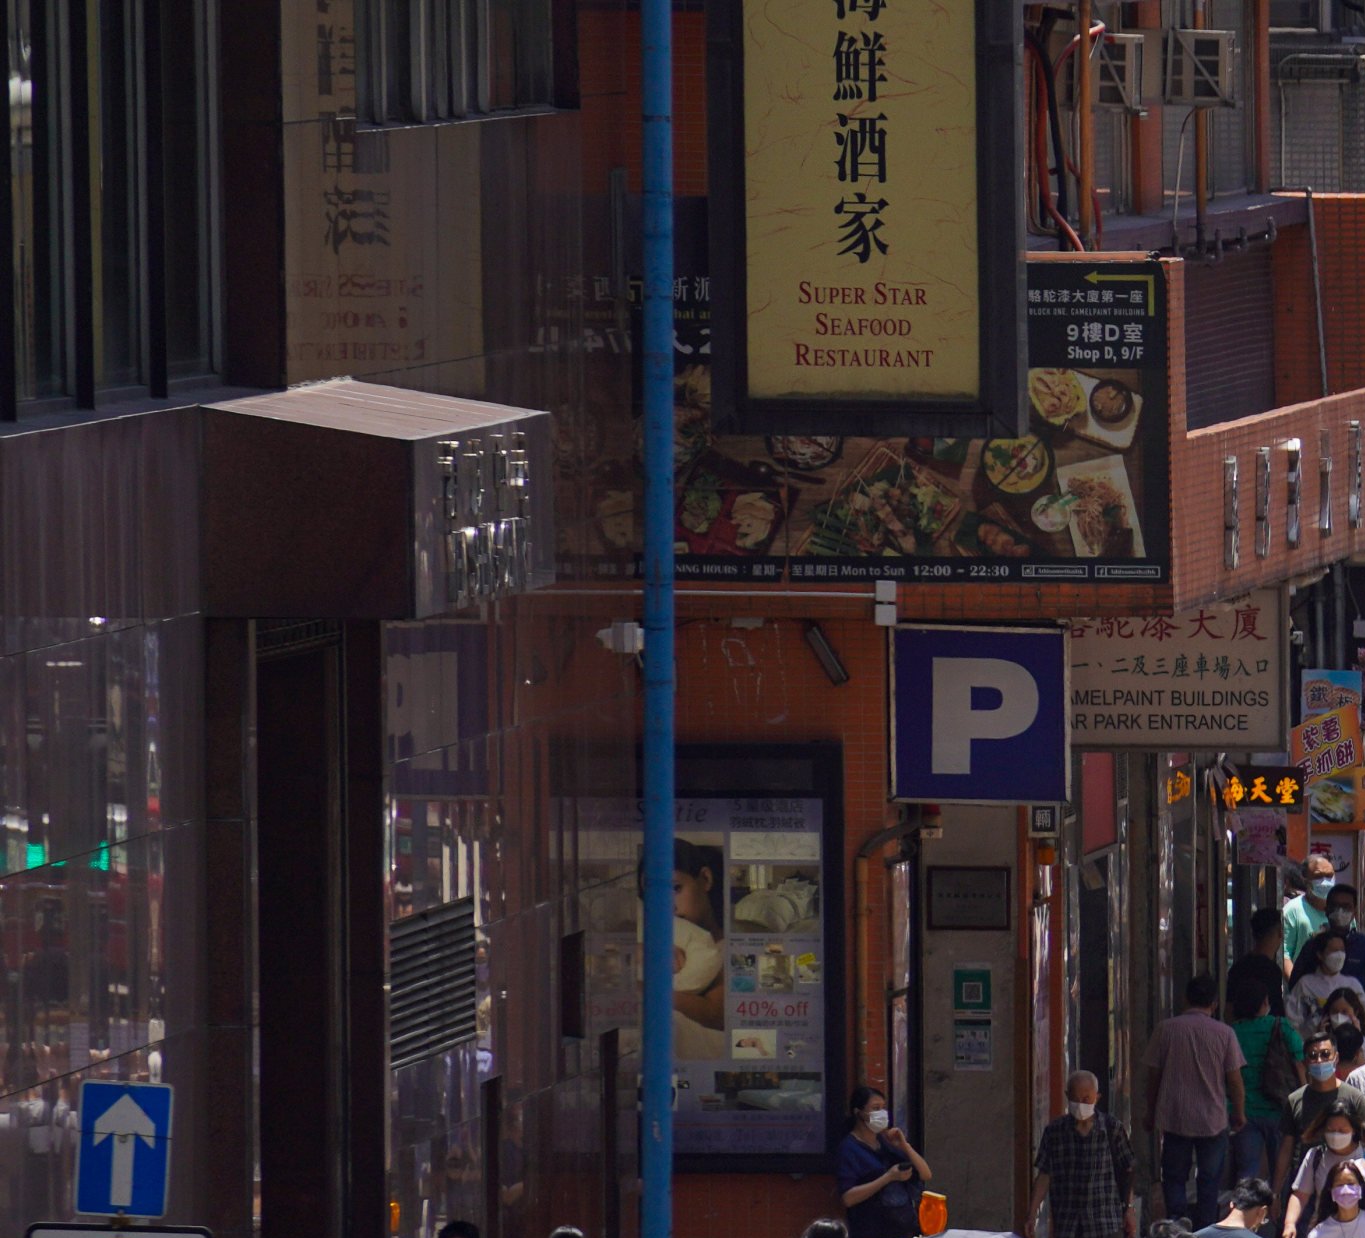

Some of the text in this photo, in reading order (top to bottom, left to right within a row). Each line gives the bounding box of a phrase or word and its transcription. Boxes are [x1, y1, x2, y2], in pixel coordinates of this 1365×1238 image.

[798, 280, 928, 307] SUPER STAR
[1028, 307, 1051, 317] BLOCK
[1113, 307, 1146, 318] BUILDING
[814, 312, 912, 337] SEAFOOD
[1065, 321, 1144, 344] 9樓D室
[794, 343, 935, 369] RESTAURANT
[1066, 345, 1145, 364] Shop D, 9/F
[702, 562, 738, 575] HOURS
[840, 564, 906, 577] Mon to Sun
[912, 564, 1011, 578] 12:00 22:30
[1071, 689, 1270, 707] MELPAINT BUILDINGS
[931, 656, 1040, 775] P
[1093, 713, 1249, 732] PARK ENTRANCE
[1302, 716, 1341, 753] 紫薯
[736, 1000, 810, 1018] 40% off
